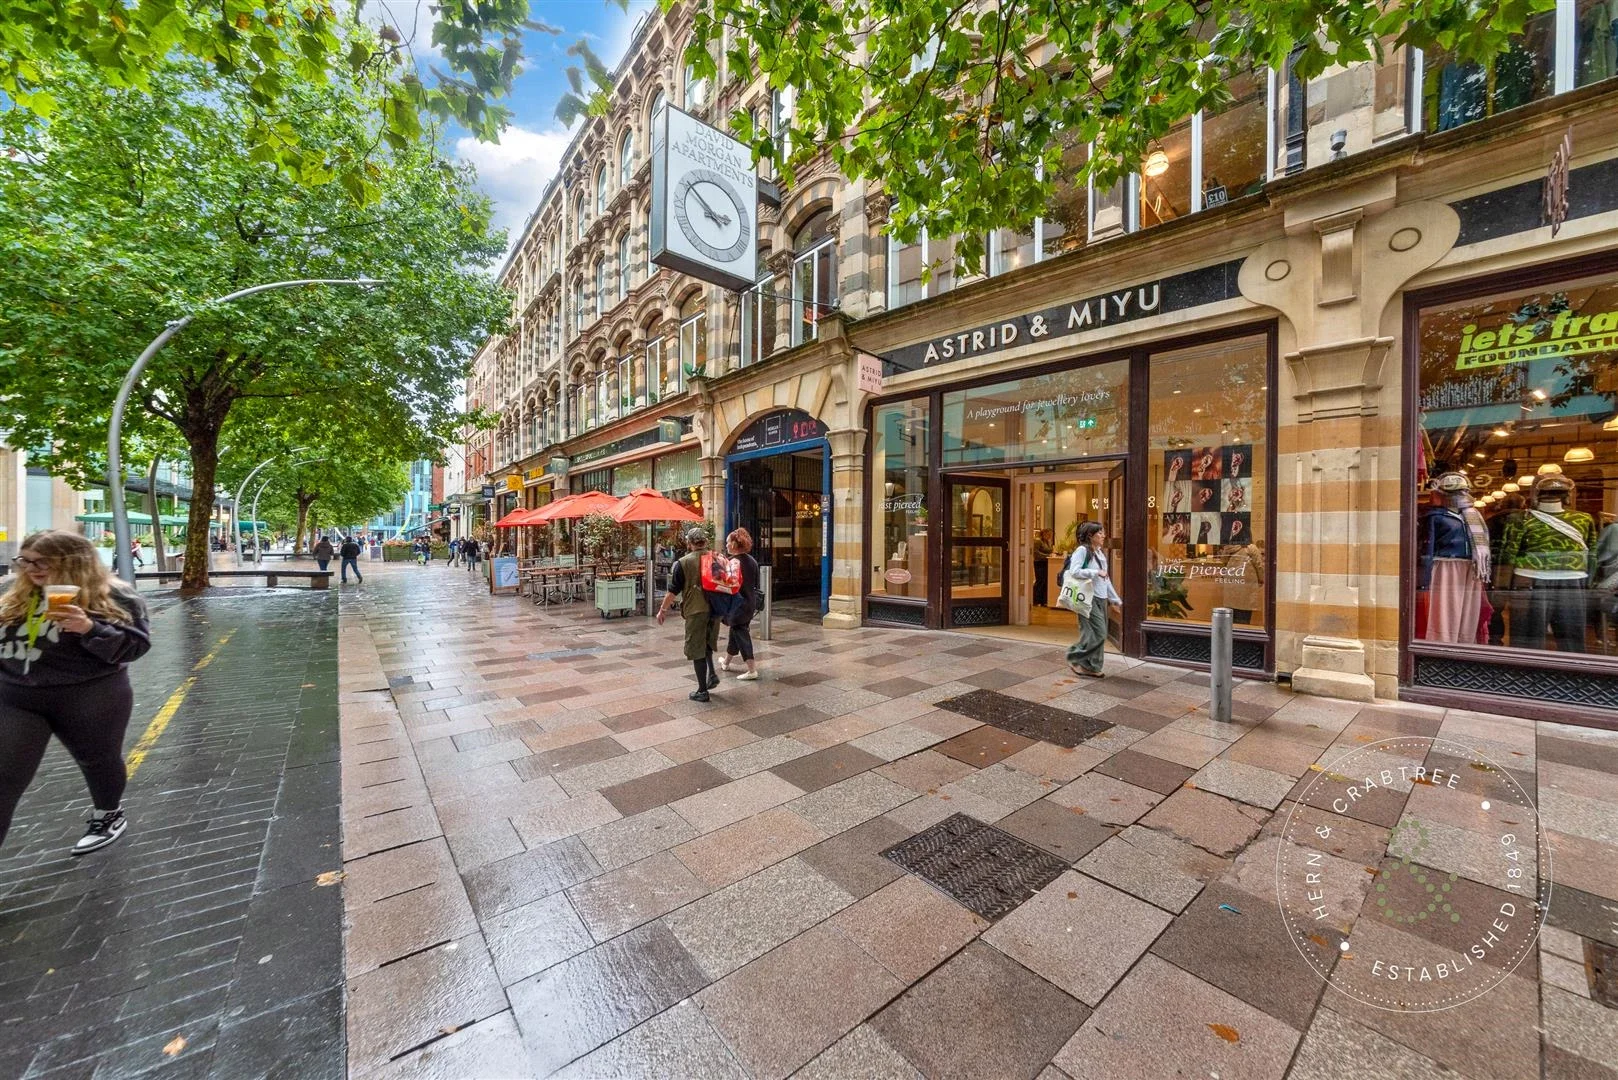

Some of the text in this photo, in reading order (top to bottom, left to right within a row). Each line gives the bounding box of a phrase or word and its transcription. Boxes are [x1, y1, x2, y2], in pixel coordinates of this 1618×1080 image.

[685, 131, 742, 168] MORGAN
[695, 122, 734, 151] DAVID
[672, 141, 754, 189] APARTMENTS
[1208, 190, 1225, 203] £10
[923, 284, 1159, 363] ASTRID & MIYU
[1459, 323, 1537, 353] iets
[1463, 336, 1618, 366] FOUNDATI
[861, 365, 882, 377] ASTRID
[867, 376, 882, 386] MIYU
[966, 389, 1111, 420] A playground for jewellery lovers
[1156, 561, 1247, 580] just pierced
[1214, 577, 1246, 585] FEELING
